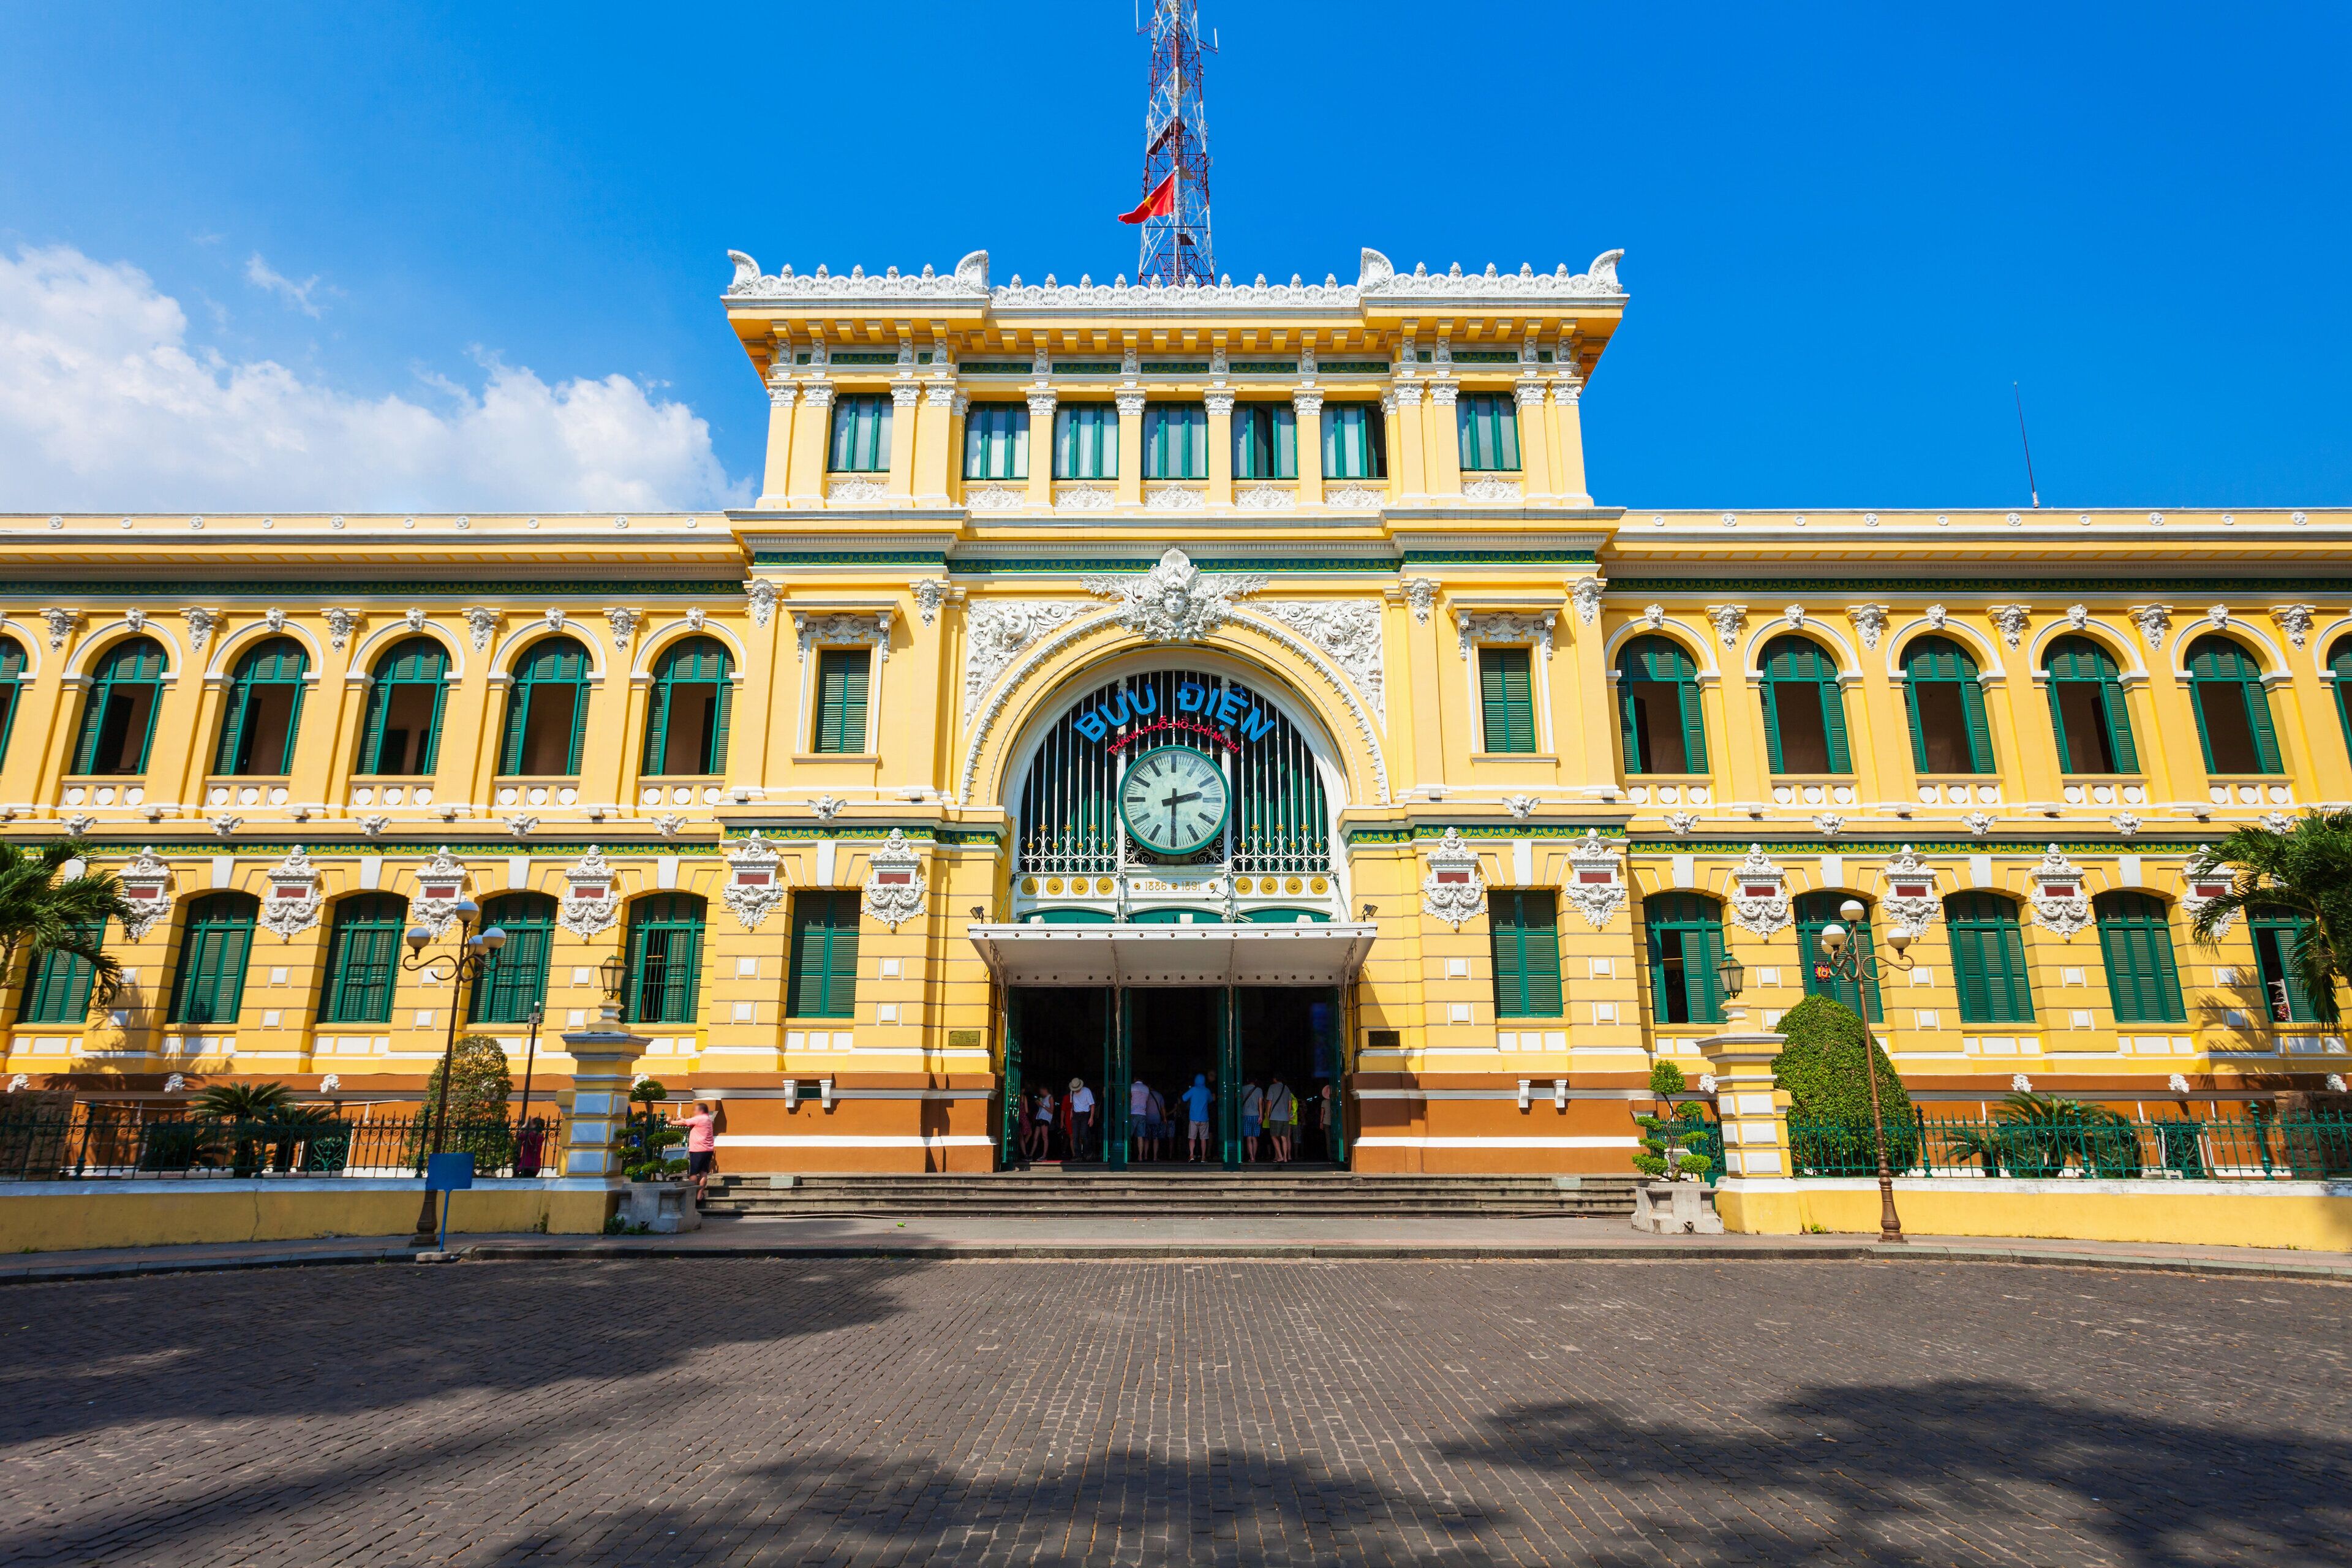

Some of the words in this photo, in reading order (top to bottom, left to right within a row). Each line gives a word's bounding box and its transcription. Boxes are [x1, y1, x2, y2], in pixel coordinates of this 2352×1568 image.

[1177, 681, 1275, 743] ĐIỆN
[1193, 723, 1216, 736] CHÍ
[1212, 731, 1240, 753] MINH
[1145, 881, 1167, 891] 1886
[1182, 881, 1200, 891] 1891
